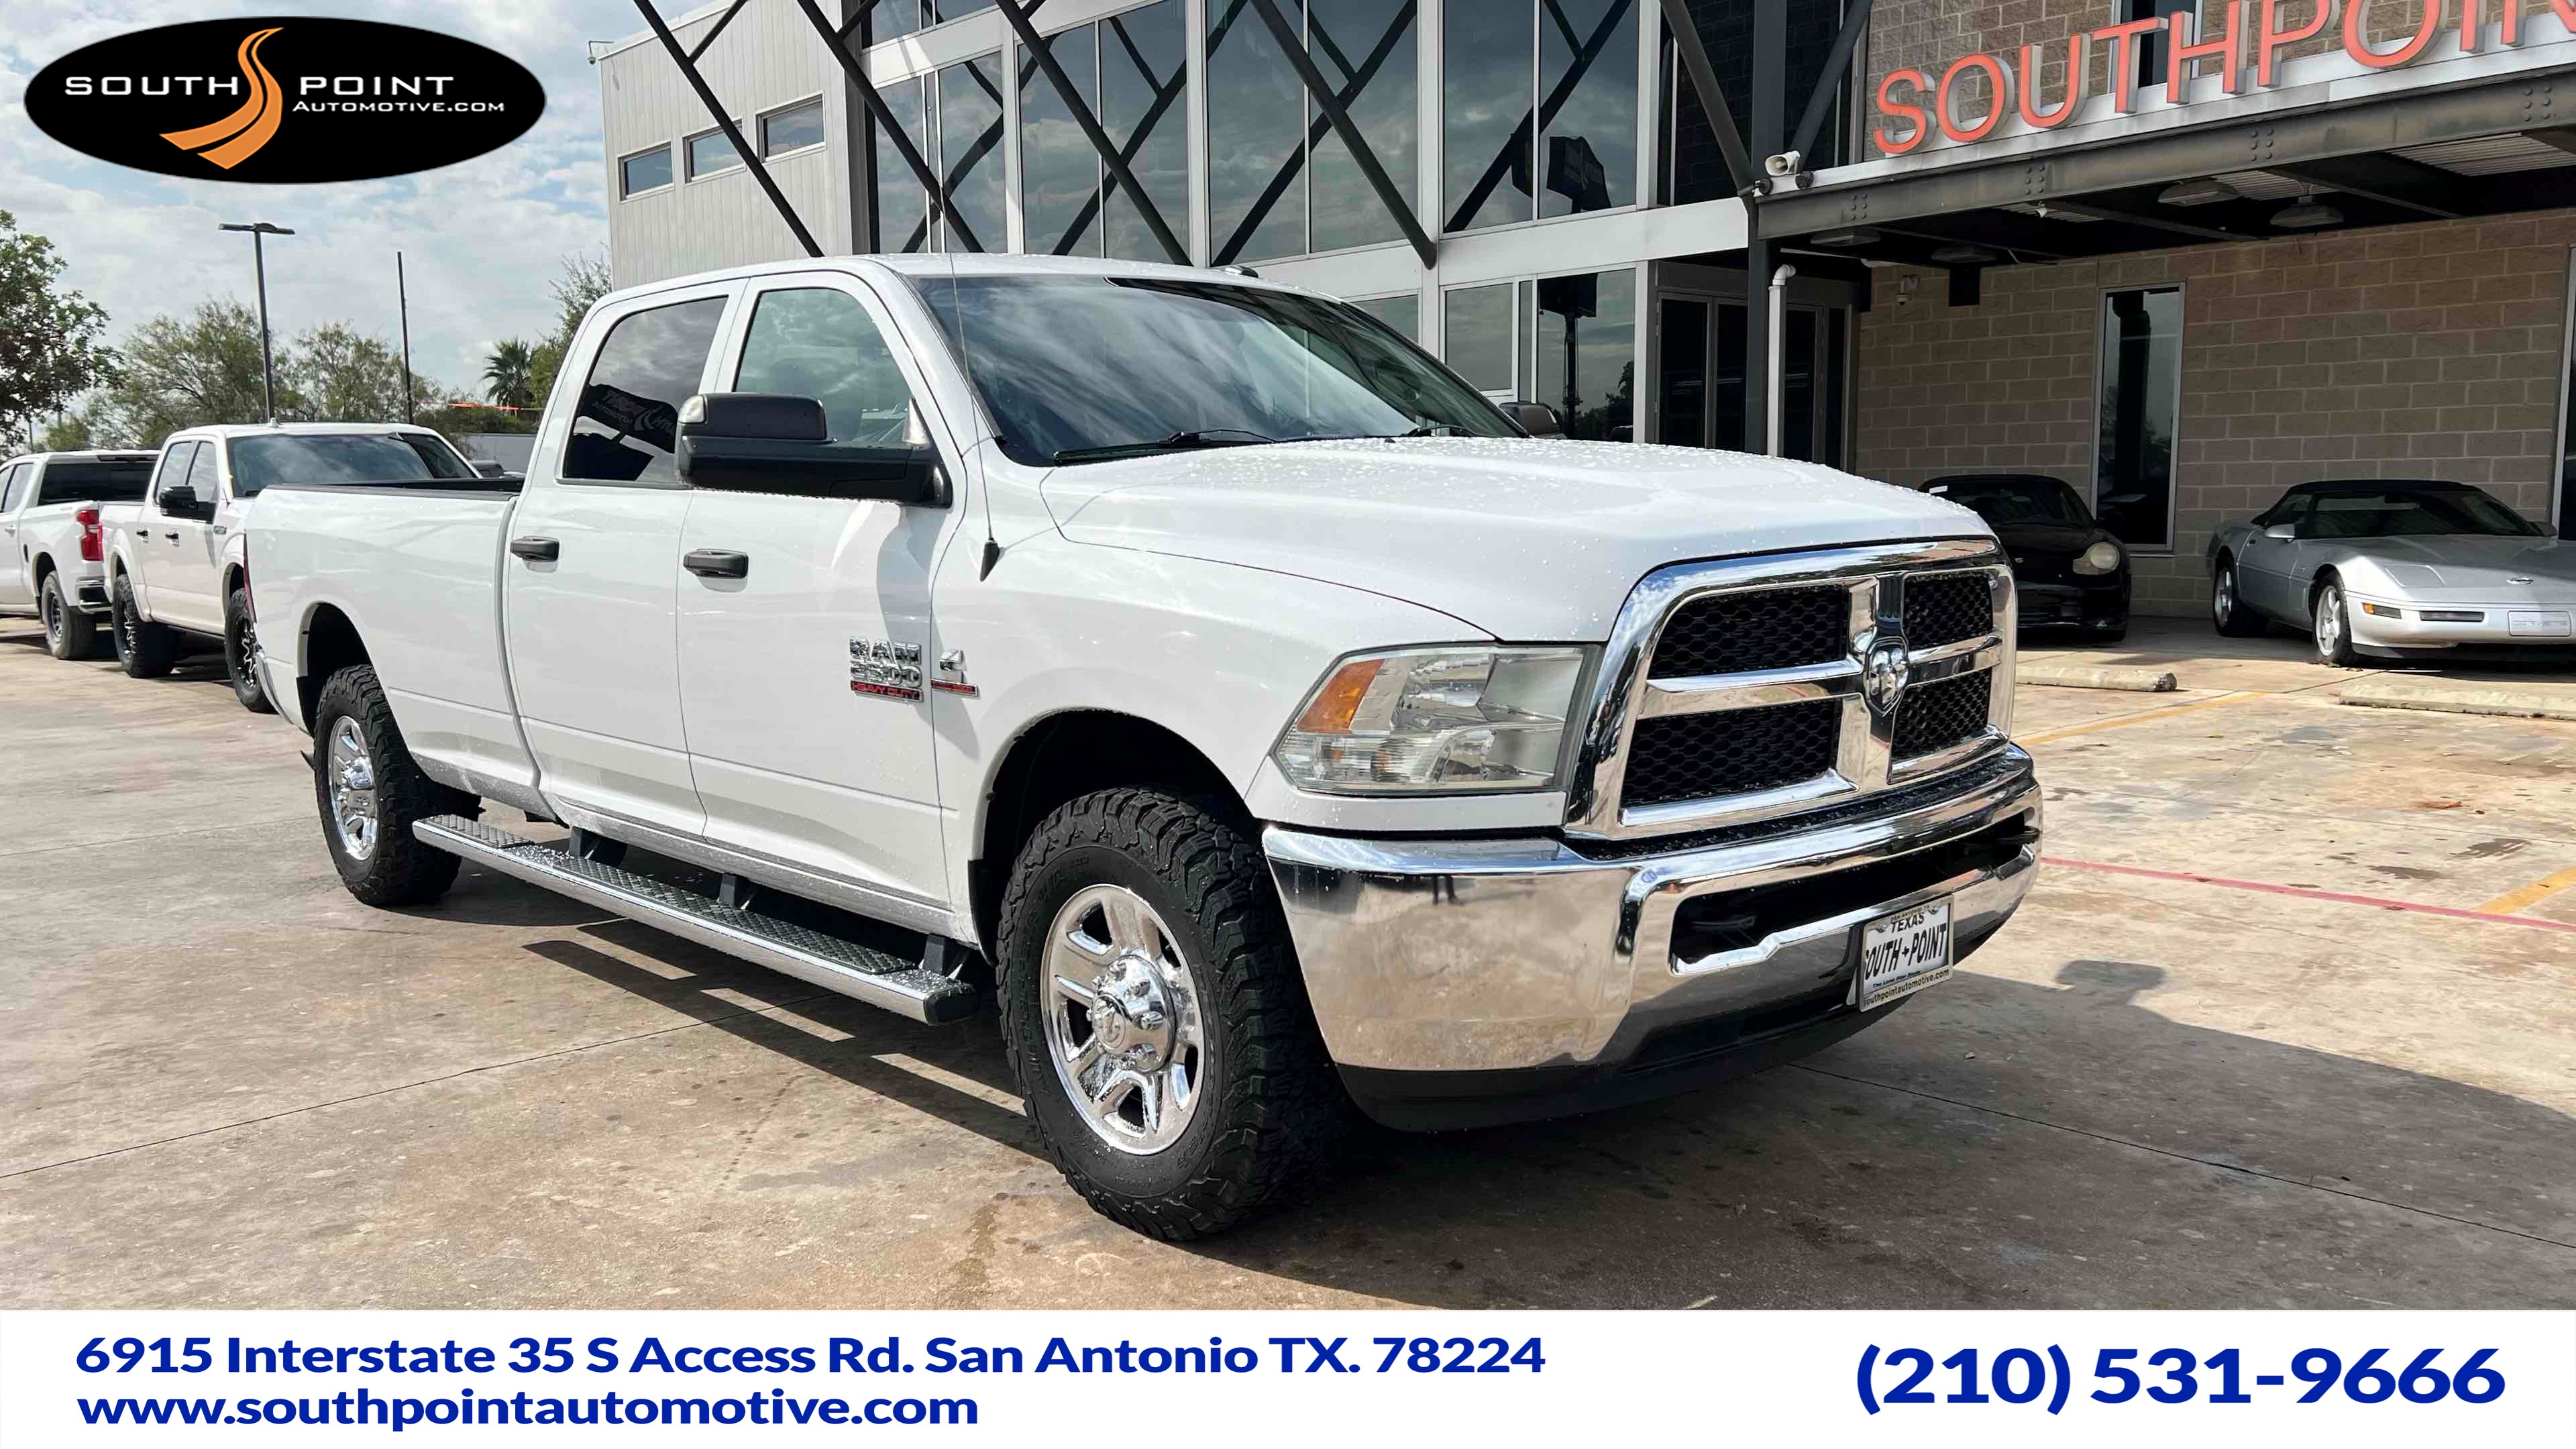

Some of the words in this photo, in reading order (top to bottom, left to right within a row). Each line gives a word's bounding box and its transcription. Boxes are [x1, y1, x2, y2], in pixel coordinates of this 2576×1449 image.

[1874, 0, 2576, 154] SOUTHPO
[849, 637, 922, 666] RAM
[852, 682, 885, 695] HEAVY
[887, 688, 920, 700] DUTY
[1891, 912, 1925, 933] TEXAS
[1908, 923, 1947, 966] POINT
[1862, 969, 1949, 1007] southpointautomotive.com
